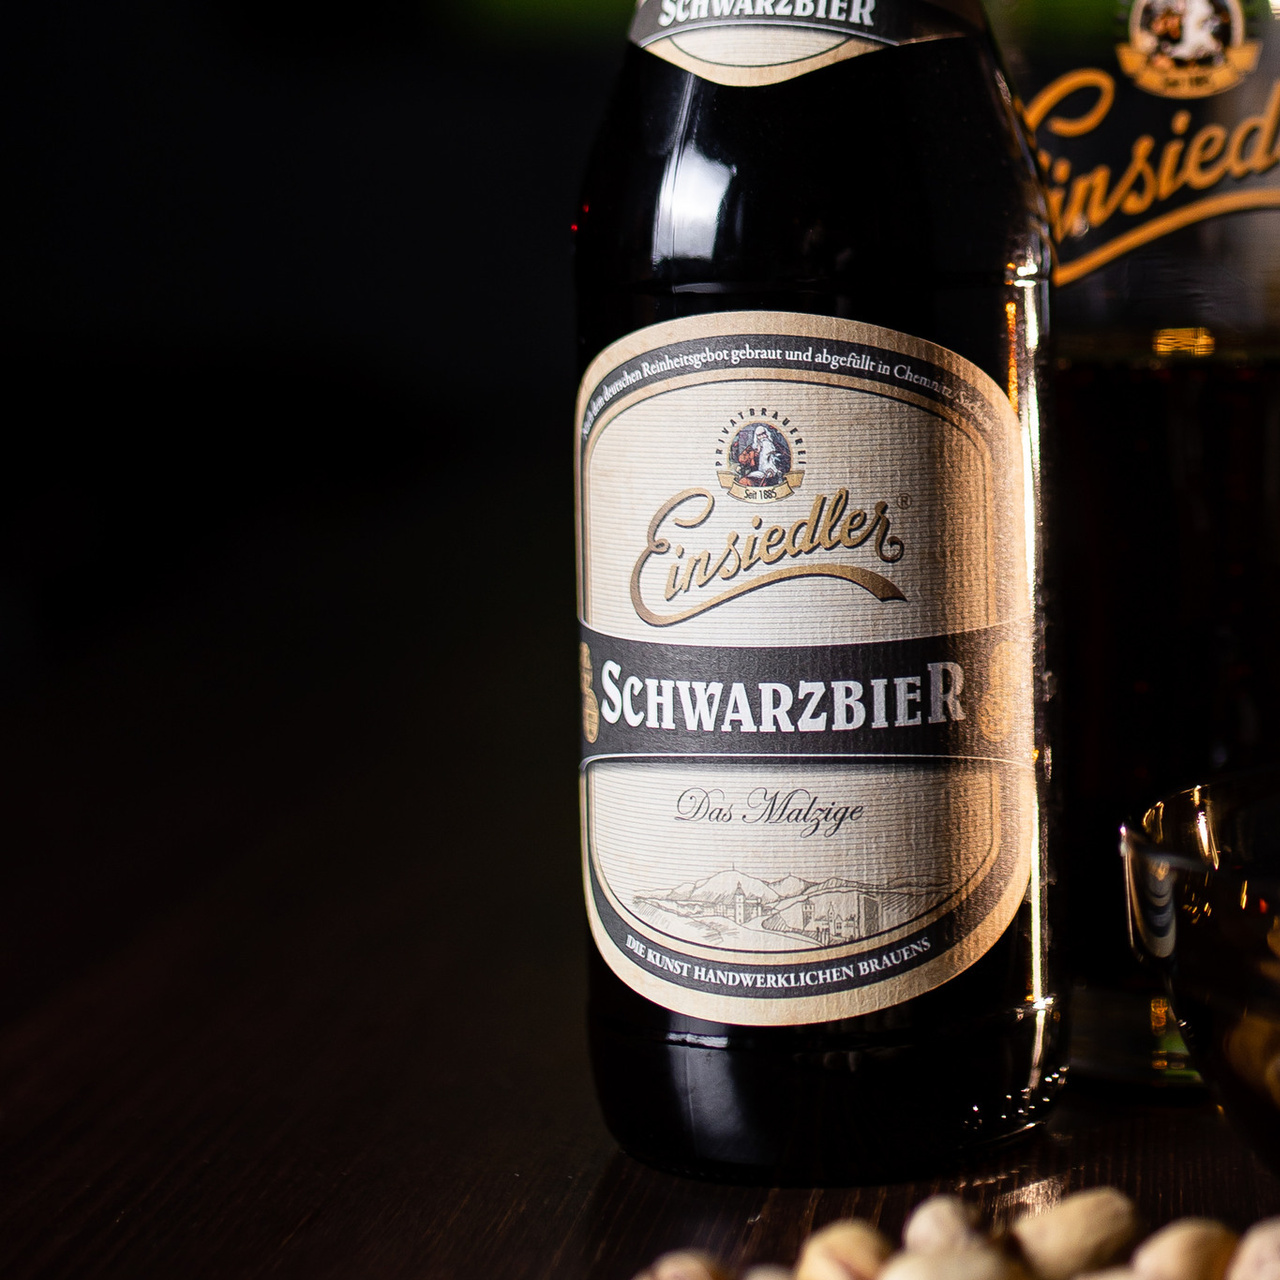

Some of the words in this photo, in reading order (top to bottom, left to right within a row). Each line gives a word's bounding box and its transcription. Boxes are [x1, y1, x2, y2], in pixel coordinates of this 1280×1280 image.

[602, 369, 643, 402] deutschen
[641, 346, 729, 379] Reinheitsgebot
[731, 344, 783, 364] gebraut
[785, 347, 813, 363] und
[814, 348, 876, 373] abgefüllt
[877, 360, 891, 376] in
[715, 407, 807, 467] PRIVATBRAUEREI
[629, 486, 909, 628] Einsiedler
[600, 659, 966, 734] SCHWARZBIER
[674, 786, 734, 823] Das
[742, 786, 865, 839] Malzige
[625, 934, 646, 959] DIE
[645, 948, 692, 978] KUNST
[693, 964, 855, 989] HANDWERKLICHEN
[857, 936, 932, 977] BRAUENS
